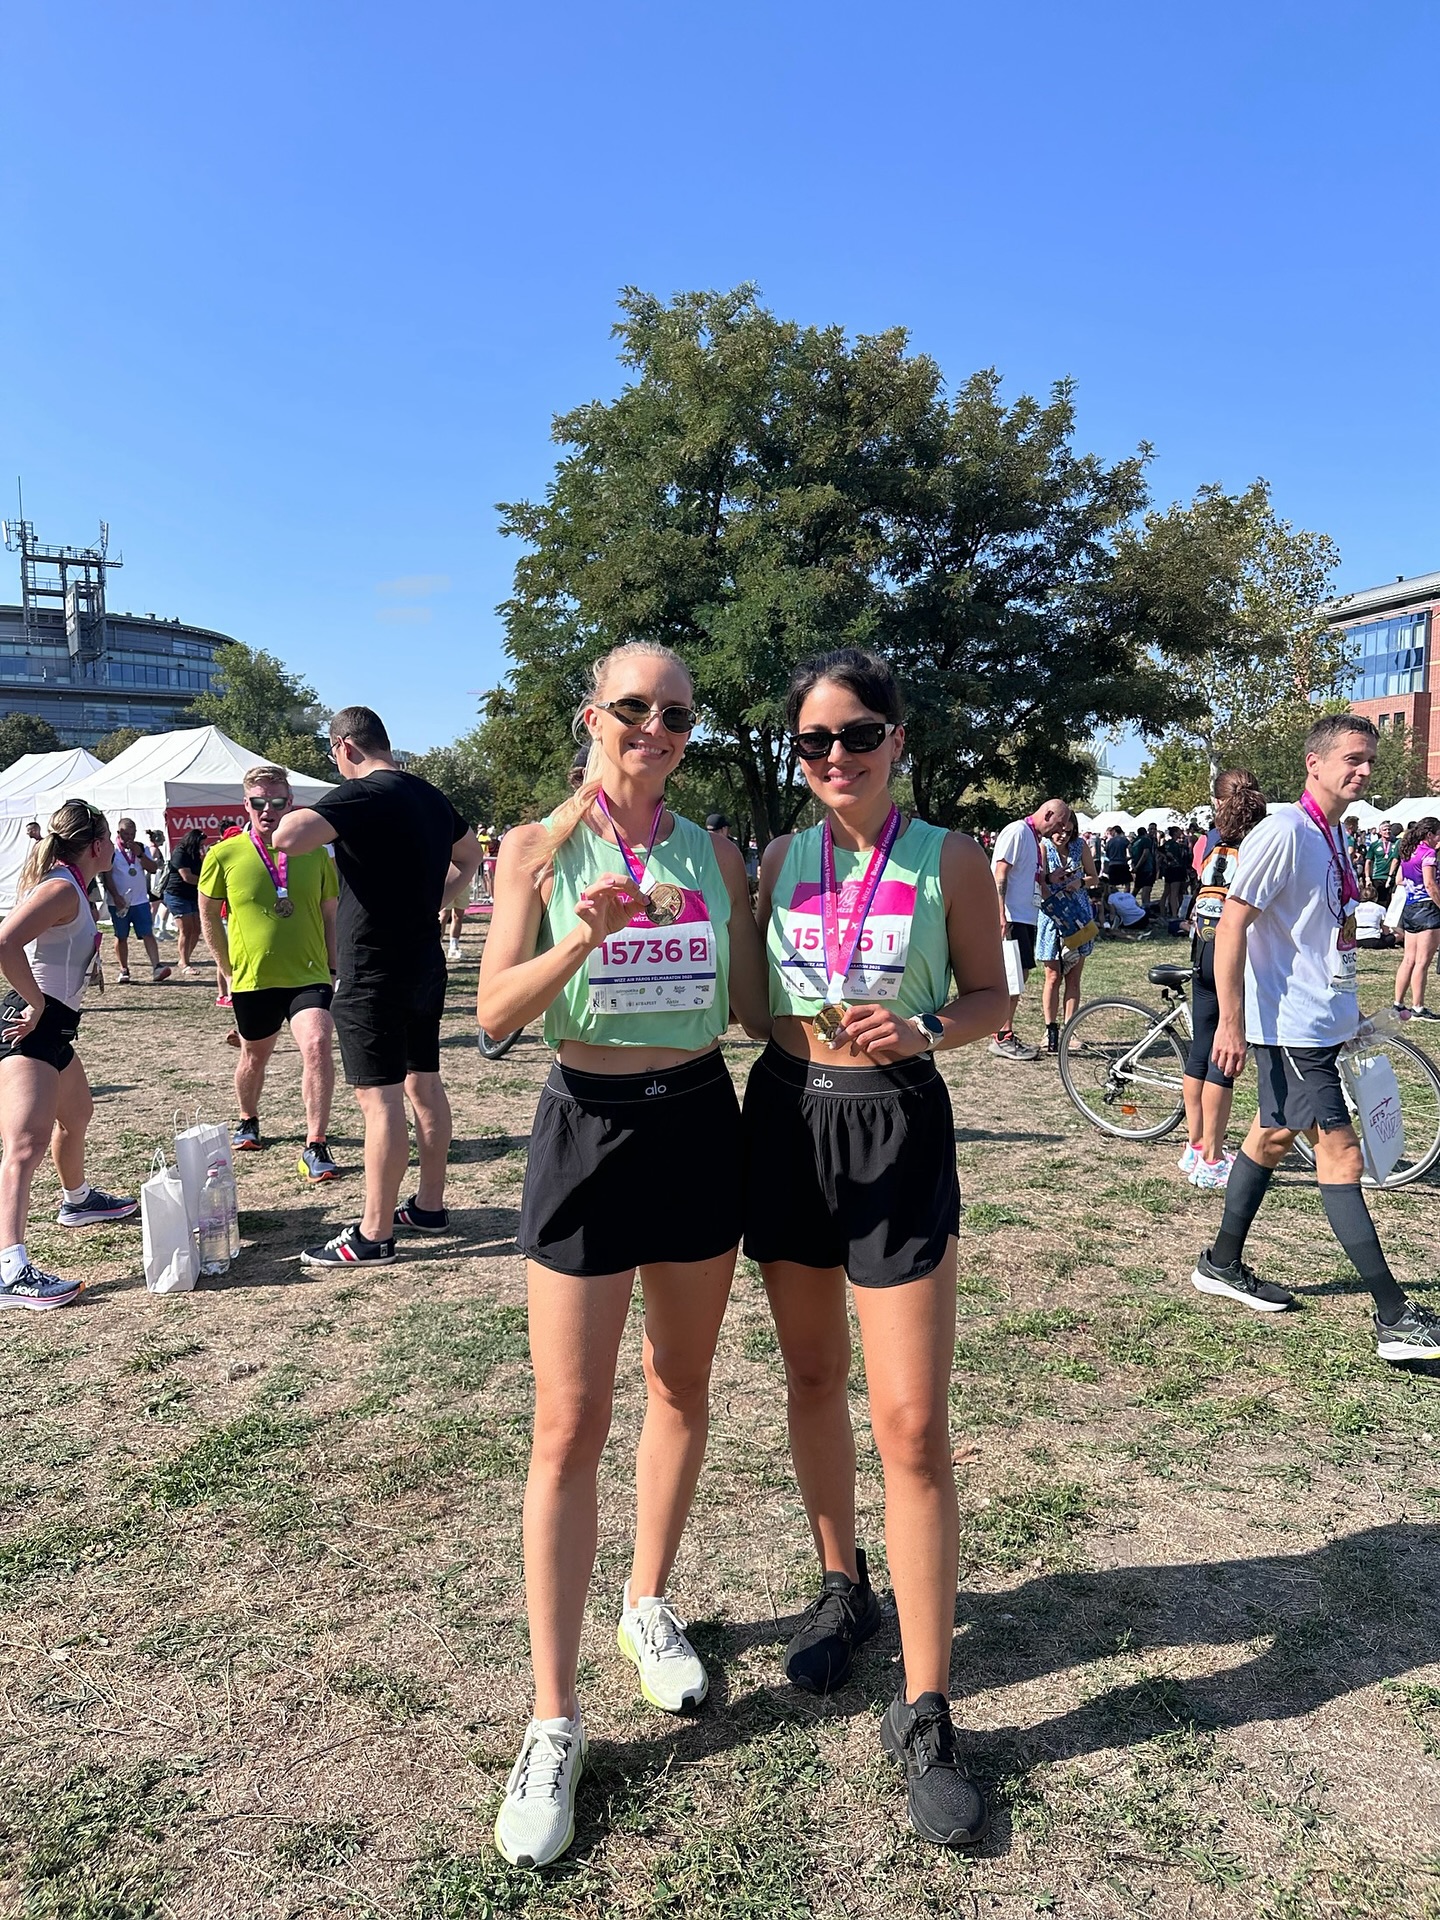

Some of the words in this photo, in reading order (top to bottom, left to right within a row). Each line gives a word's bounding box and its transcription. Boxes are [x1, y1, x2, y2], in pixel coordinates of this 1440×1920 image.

[172, 814, 219, 830] VÁLTÓ
[870, 847, 886, 876] Budapest
[825, 902, 833, 918] 2025
[792, 928, 874, 952] 156
[886, 933, 895, 951] 1
[598, 939, 683, 965] 15736
[691, 940, 706, 960] 2
[645, 1080, 667, 1096] alo
[812, 1073, 834, 1089] alo
[1369, 1109, 1386, 1128] LET'S
[12, 1284, 40, 1298] HOKA
